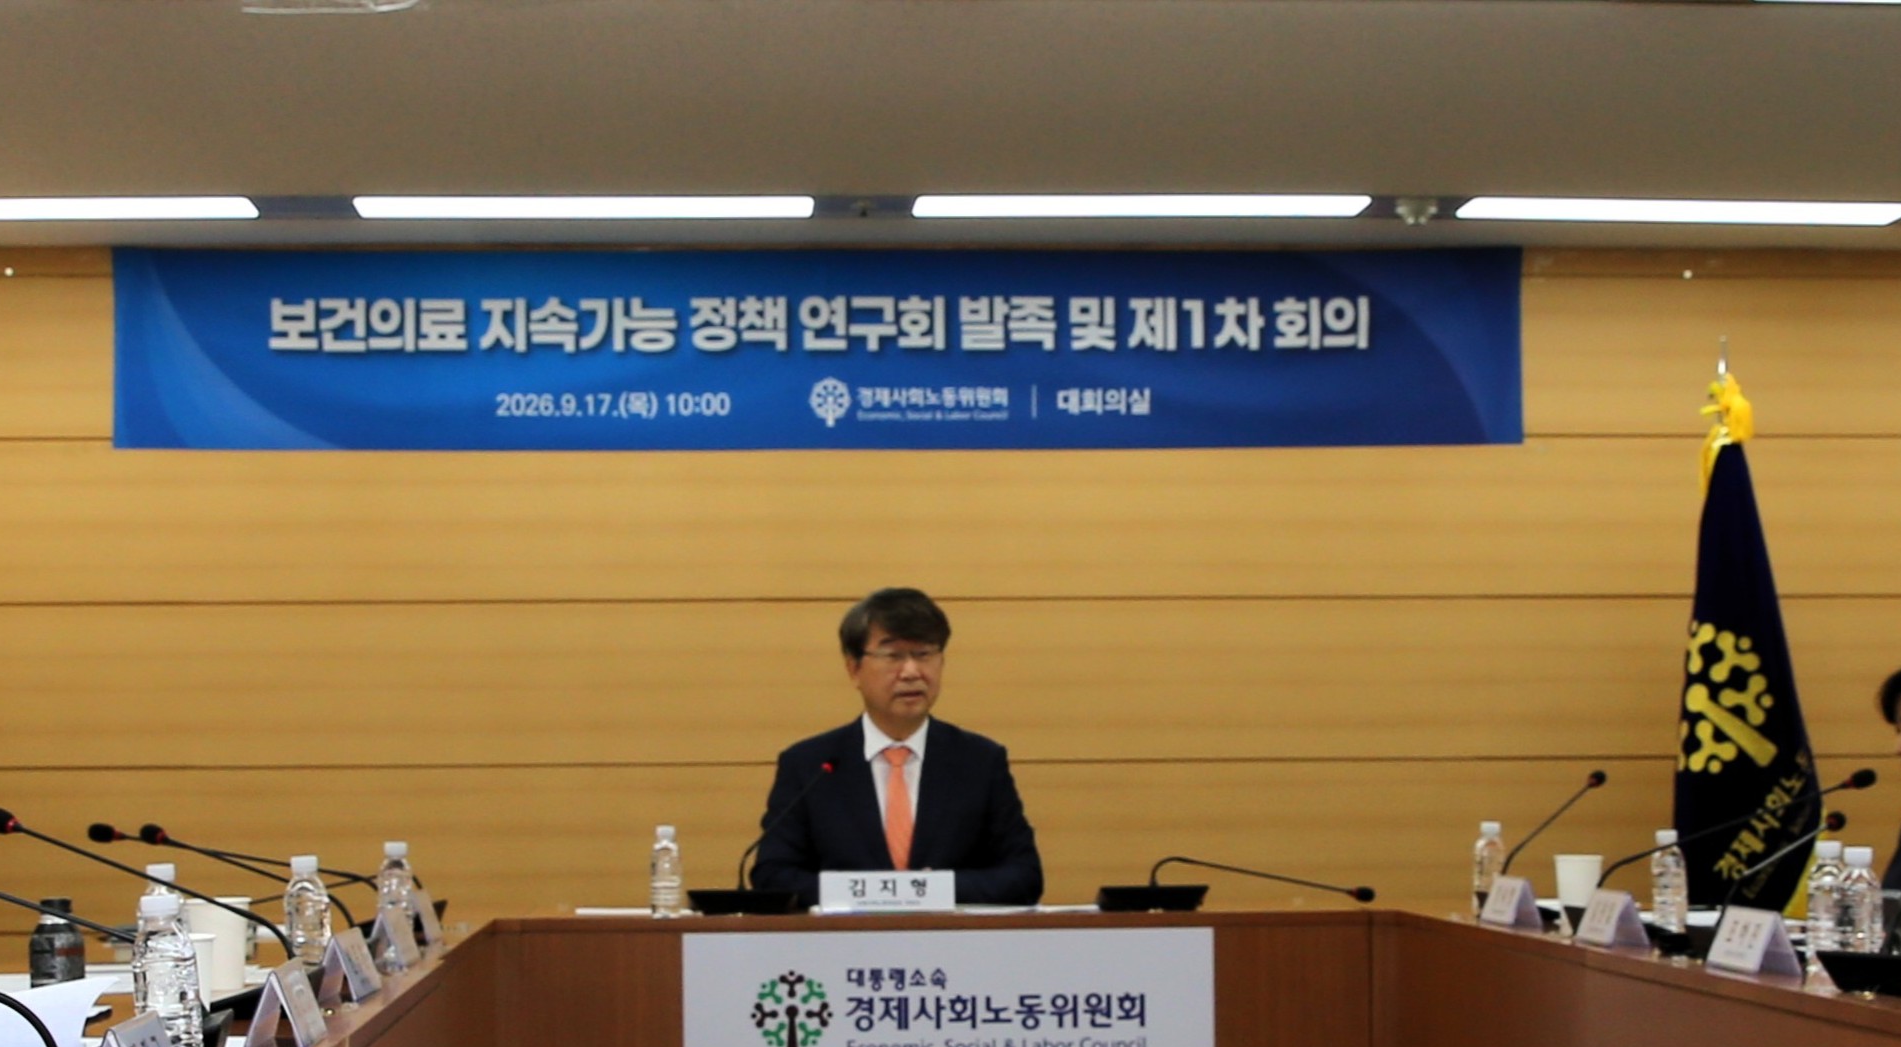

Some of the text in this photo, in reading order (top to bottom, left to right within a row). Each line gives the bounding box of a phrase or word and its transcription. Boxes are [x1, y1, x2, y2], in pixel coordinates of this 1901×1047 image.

[268, 296, 1369, 352] 보건의료 지속가능 정책 연구회 발족 및 제1차 회의
[496, 392, 731, 419] 2026.9.17.(목) 10:00
[857, 387, 1009, 408] 경제사회노동위원회
[1056, 387, 1151, 415] 대회의실
[846, 967, 947, 992] 대통령소속
[845, 992, 1147, 1033] 경제사회노동위원회
